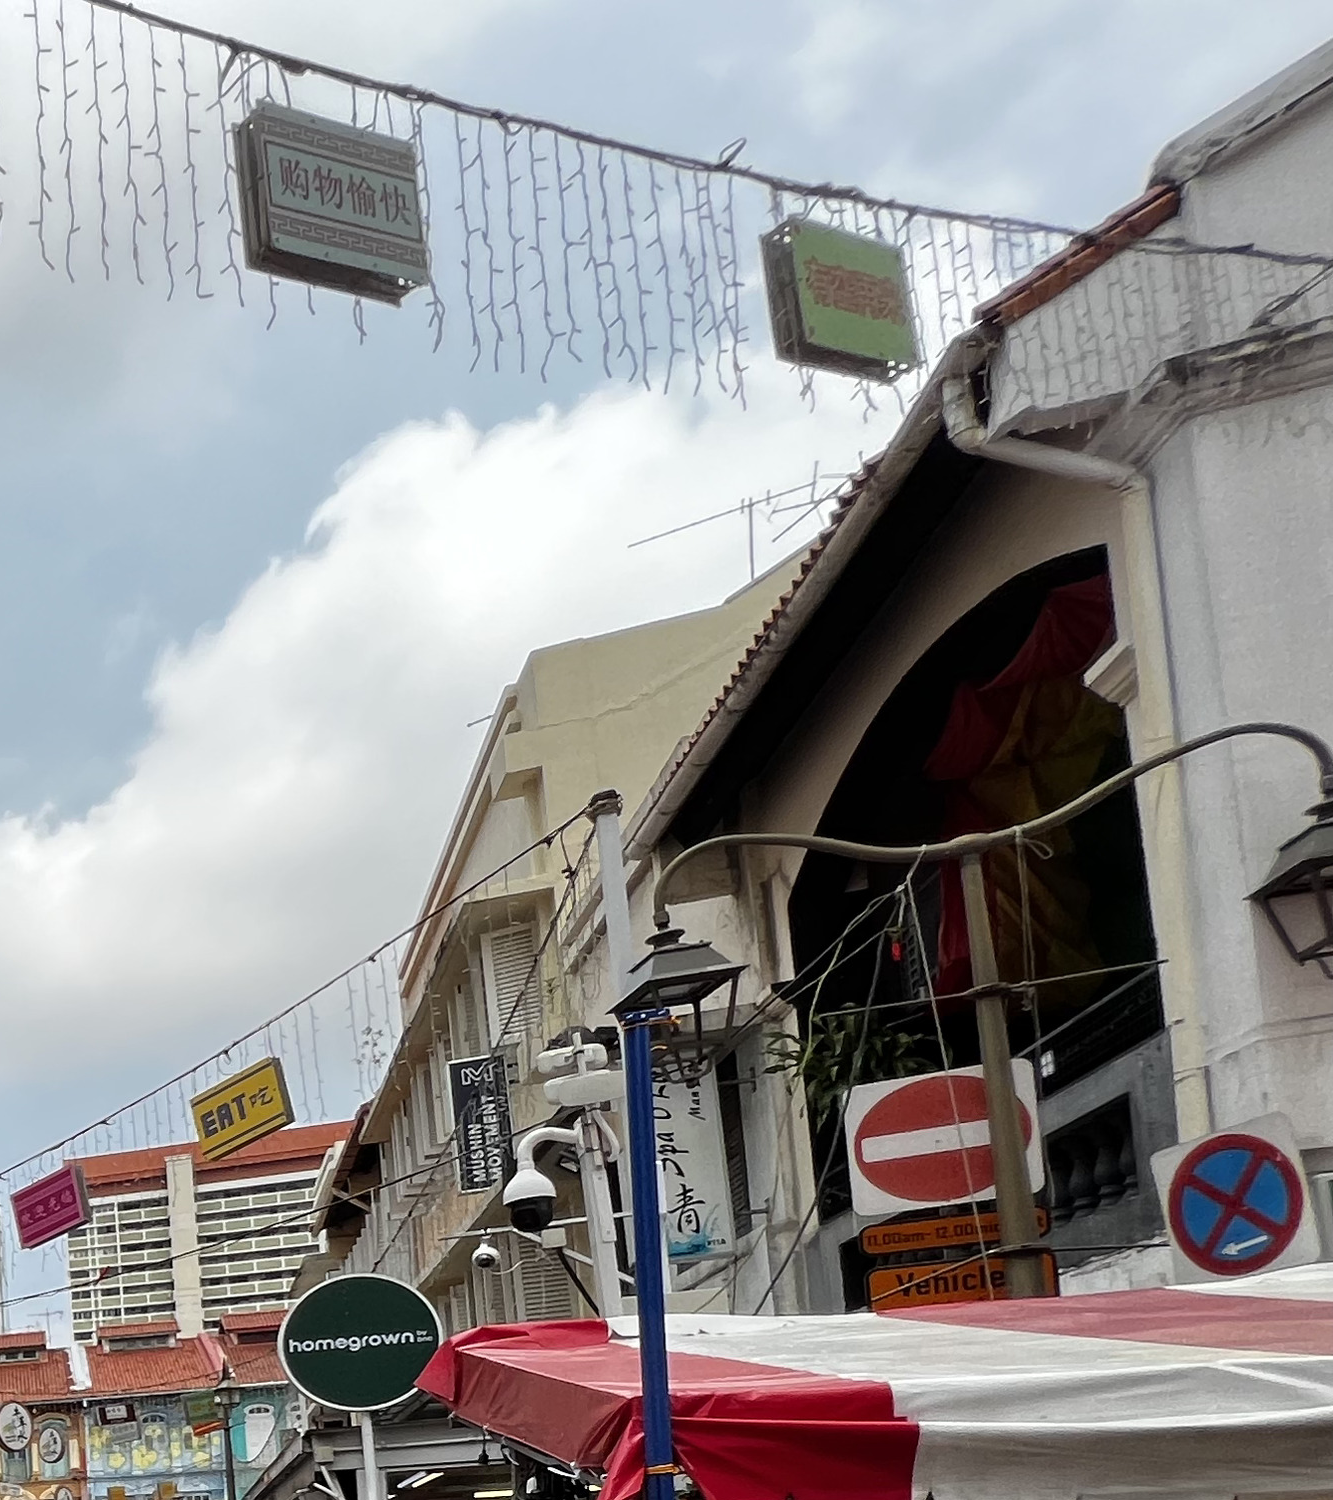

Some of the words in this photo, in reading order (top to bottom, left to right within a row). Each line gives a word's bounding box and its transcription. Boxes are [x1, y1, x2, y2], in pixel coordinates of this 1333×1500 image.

[278, 158, 412, 226] 购物愉快
[200, 1092, 247, 1139] EAT
[480, 1095, 503, 1181] MOVEMENT
[467, 1123, 488, 1183] MUSHIN
[895, 1266, 1006, 1298] Vehicle
[288, 1331, 415, 1353] homegrown
